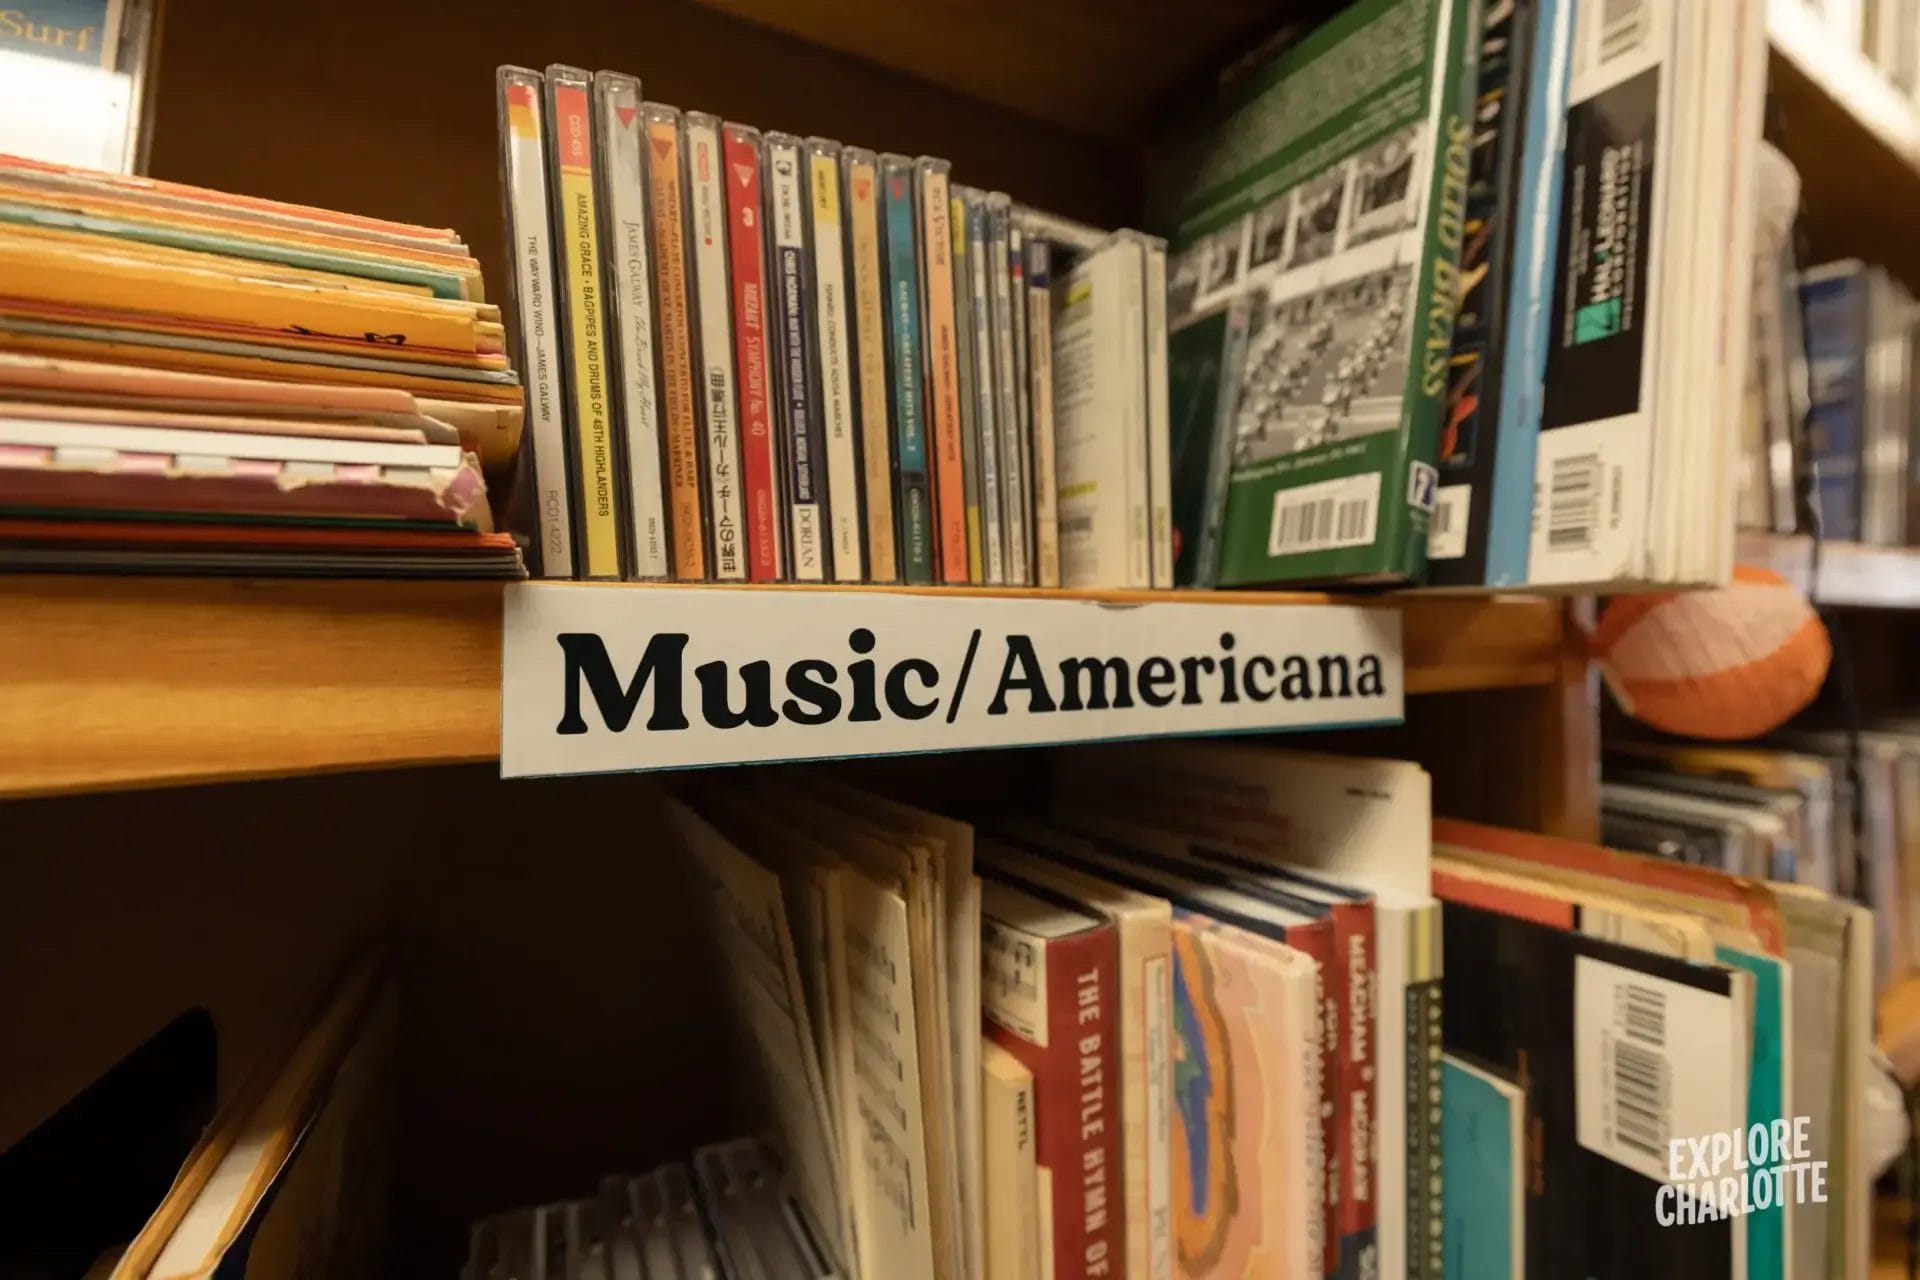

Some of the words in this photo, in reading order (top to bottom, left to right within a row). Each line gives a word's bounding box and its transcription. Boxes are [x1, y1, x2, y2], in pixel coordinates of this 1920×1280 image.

[1438, 115, 1470, 251] SOLID
[576, 193, 590, 239] AMAZING
[623, 220, 640, 257] JAMES
[527, 235, 538, 256] THE
[580, 241, 593, 277] GRACE
[529, 257, 542, 307] WAYWARD
[628, 259, 643, 307] GALWAY
[743, 282, 758, 330] MOZART
[583, 286, 597, 337] BAGPIPES
[1423, 256, 1459, 397] BRASS
[587, 340, 599, 361] AND
[746, 336, 763, 396] SYMPHONY
[539, 383, 551, 423] GALWAY
[588, 363, 602, 399] DRUMS
[591, 402, 602, 417] OF
[593, 418, 604, 443] 48TH
[752, 421, 766, 436] 40
[595, 445, 609, 517] HIGHLANDERS
[798, 507, 815, 568] DORIAN
[1076, 968, 1100, 1026] THE
[1079, 1033, 1105, 1141] BATTLE
[1082, 1147, 1107, 1233] HYMN
[1085, 1239, 1109, 1280] OF
